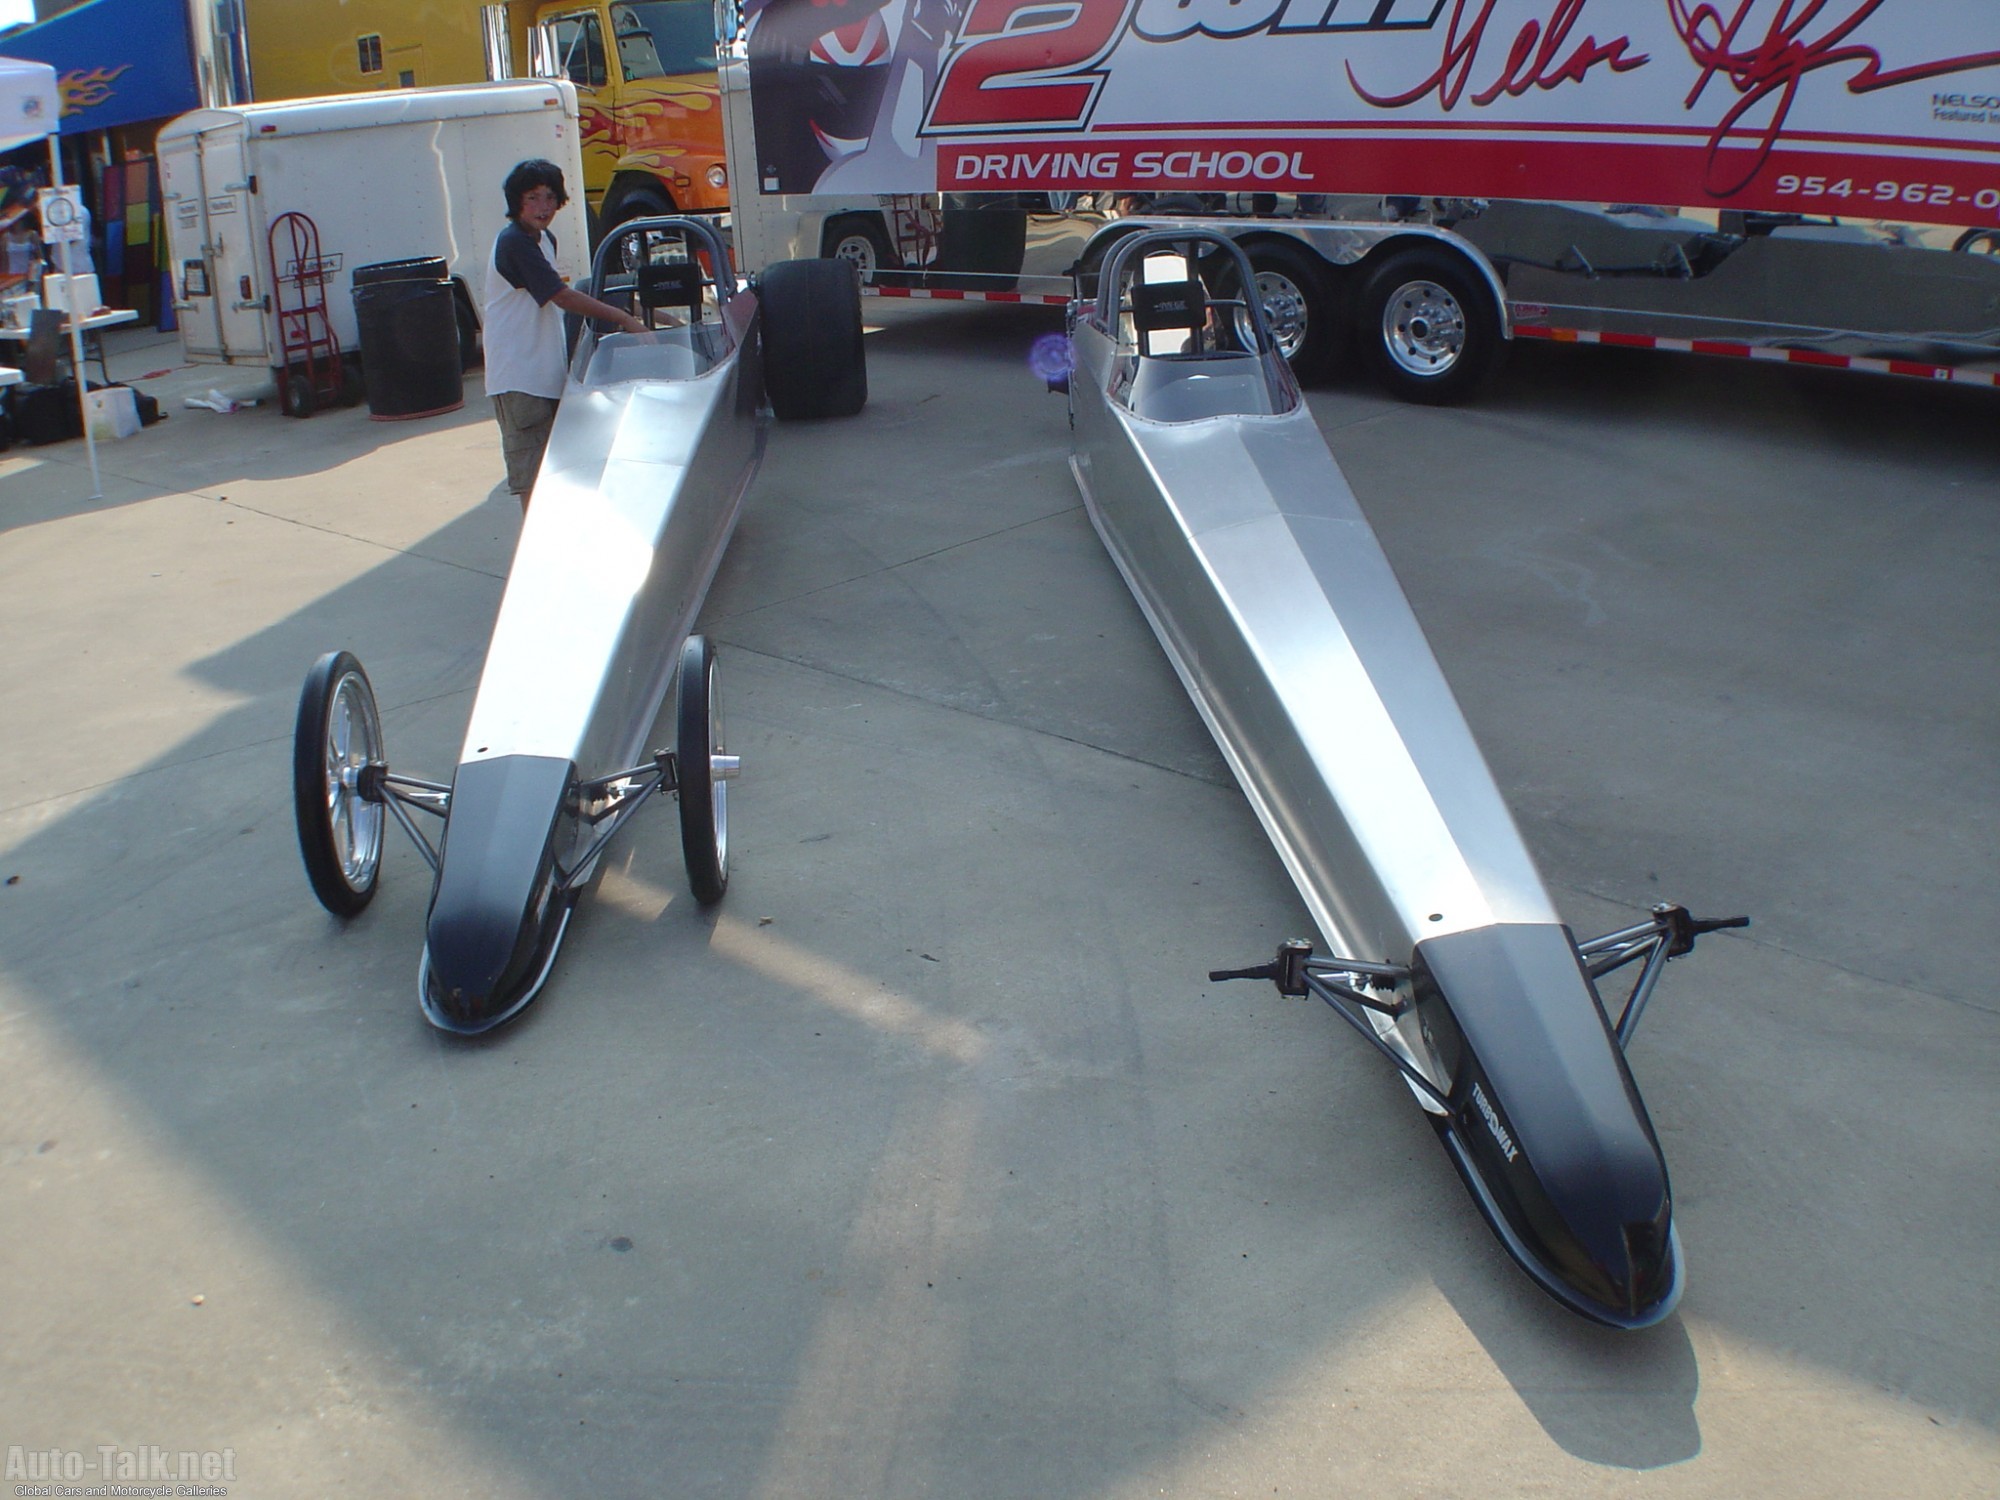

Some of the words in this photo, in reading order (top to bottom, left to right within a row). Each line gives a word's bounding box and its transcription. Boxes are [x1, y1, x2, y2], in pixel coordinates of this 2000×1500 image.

[1933, 107, 1985, 122] Featured
[955, 152, 1120, 180] DRIVING
[1132, 151, 1315, 180] SCHOOL
